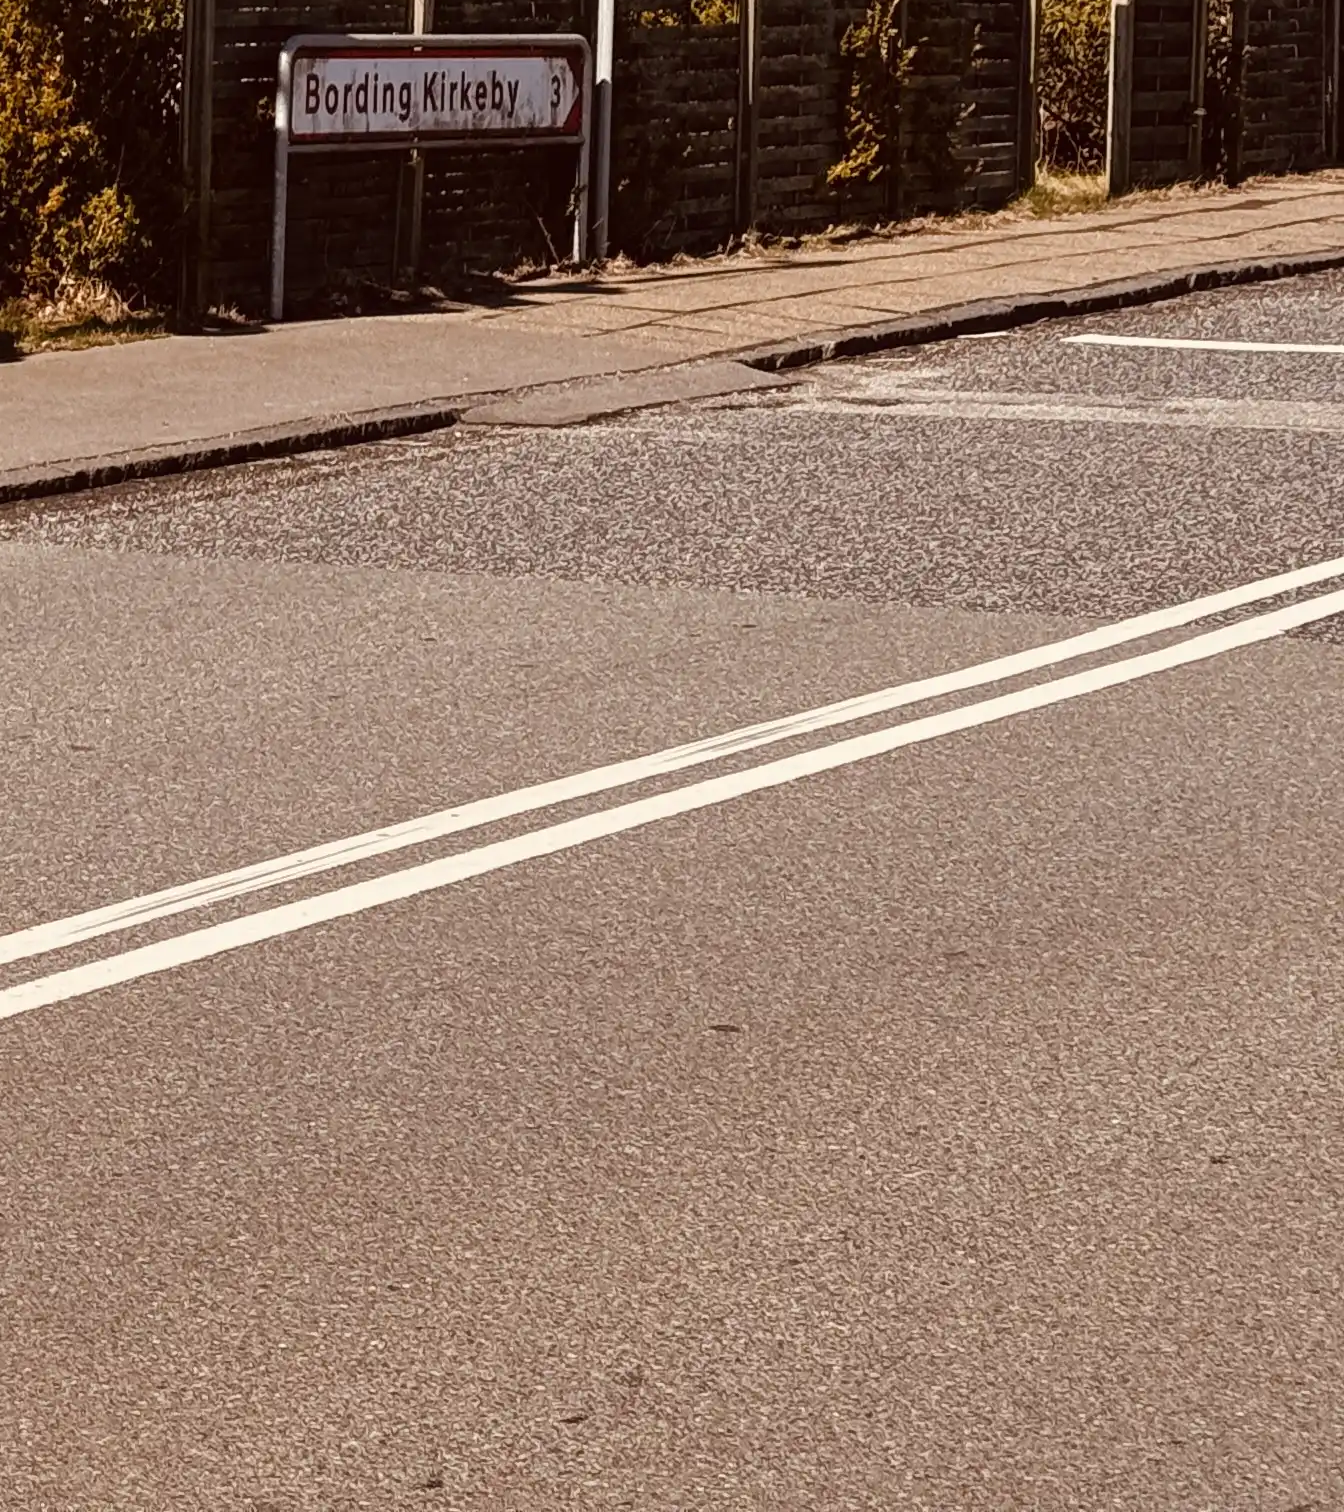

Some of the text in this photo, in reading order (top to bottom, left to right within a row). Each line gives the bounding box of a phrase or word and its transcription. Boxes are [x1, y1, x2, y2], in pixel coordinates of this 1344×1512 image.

[305, 70, 562, 123] Bording Kirkeby 3
